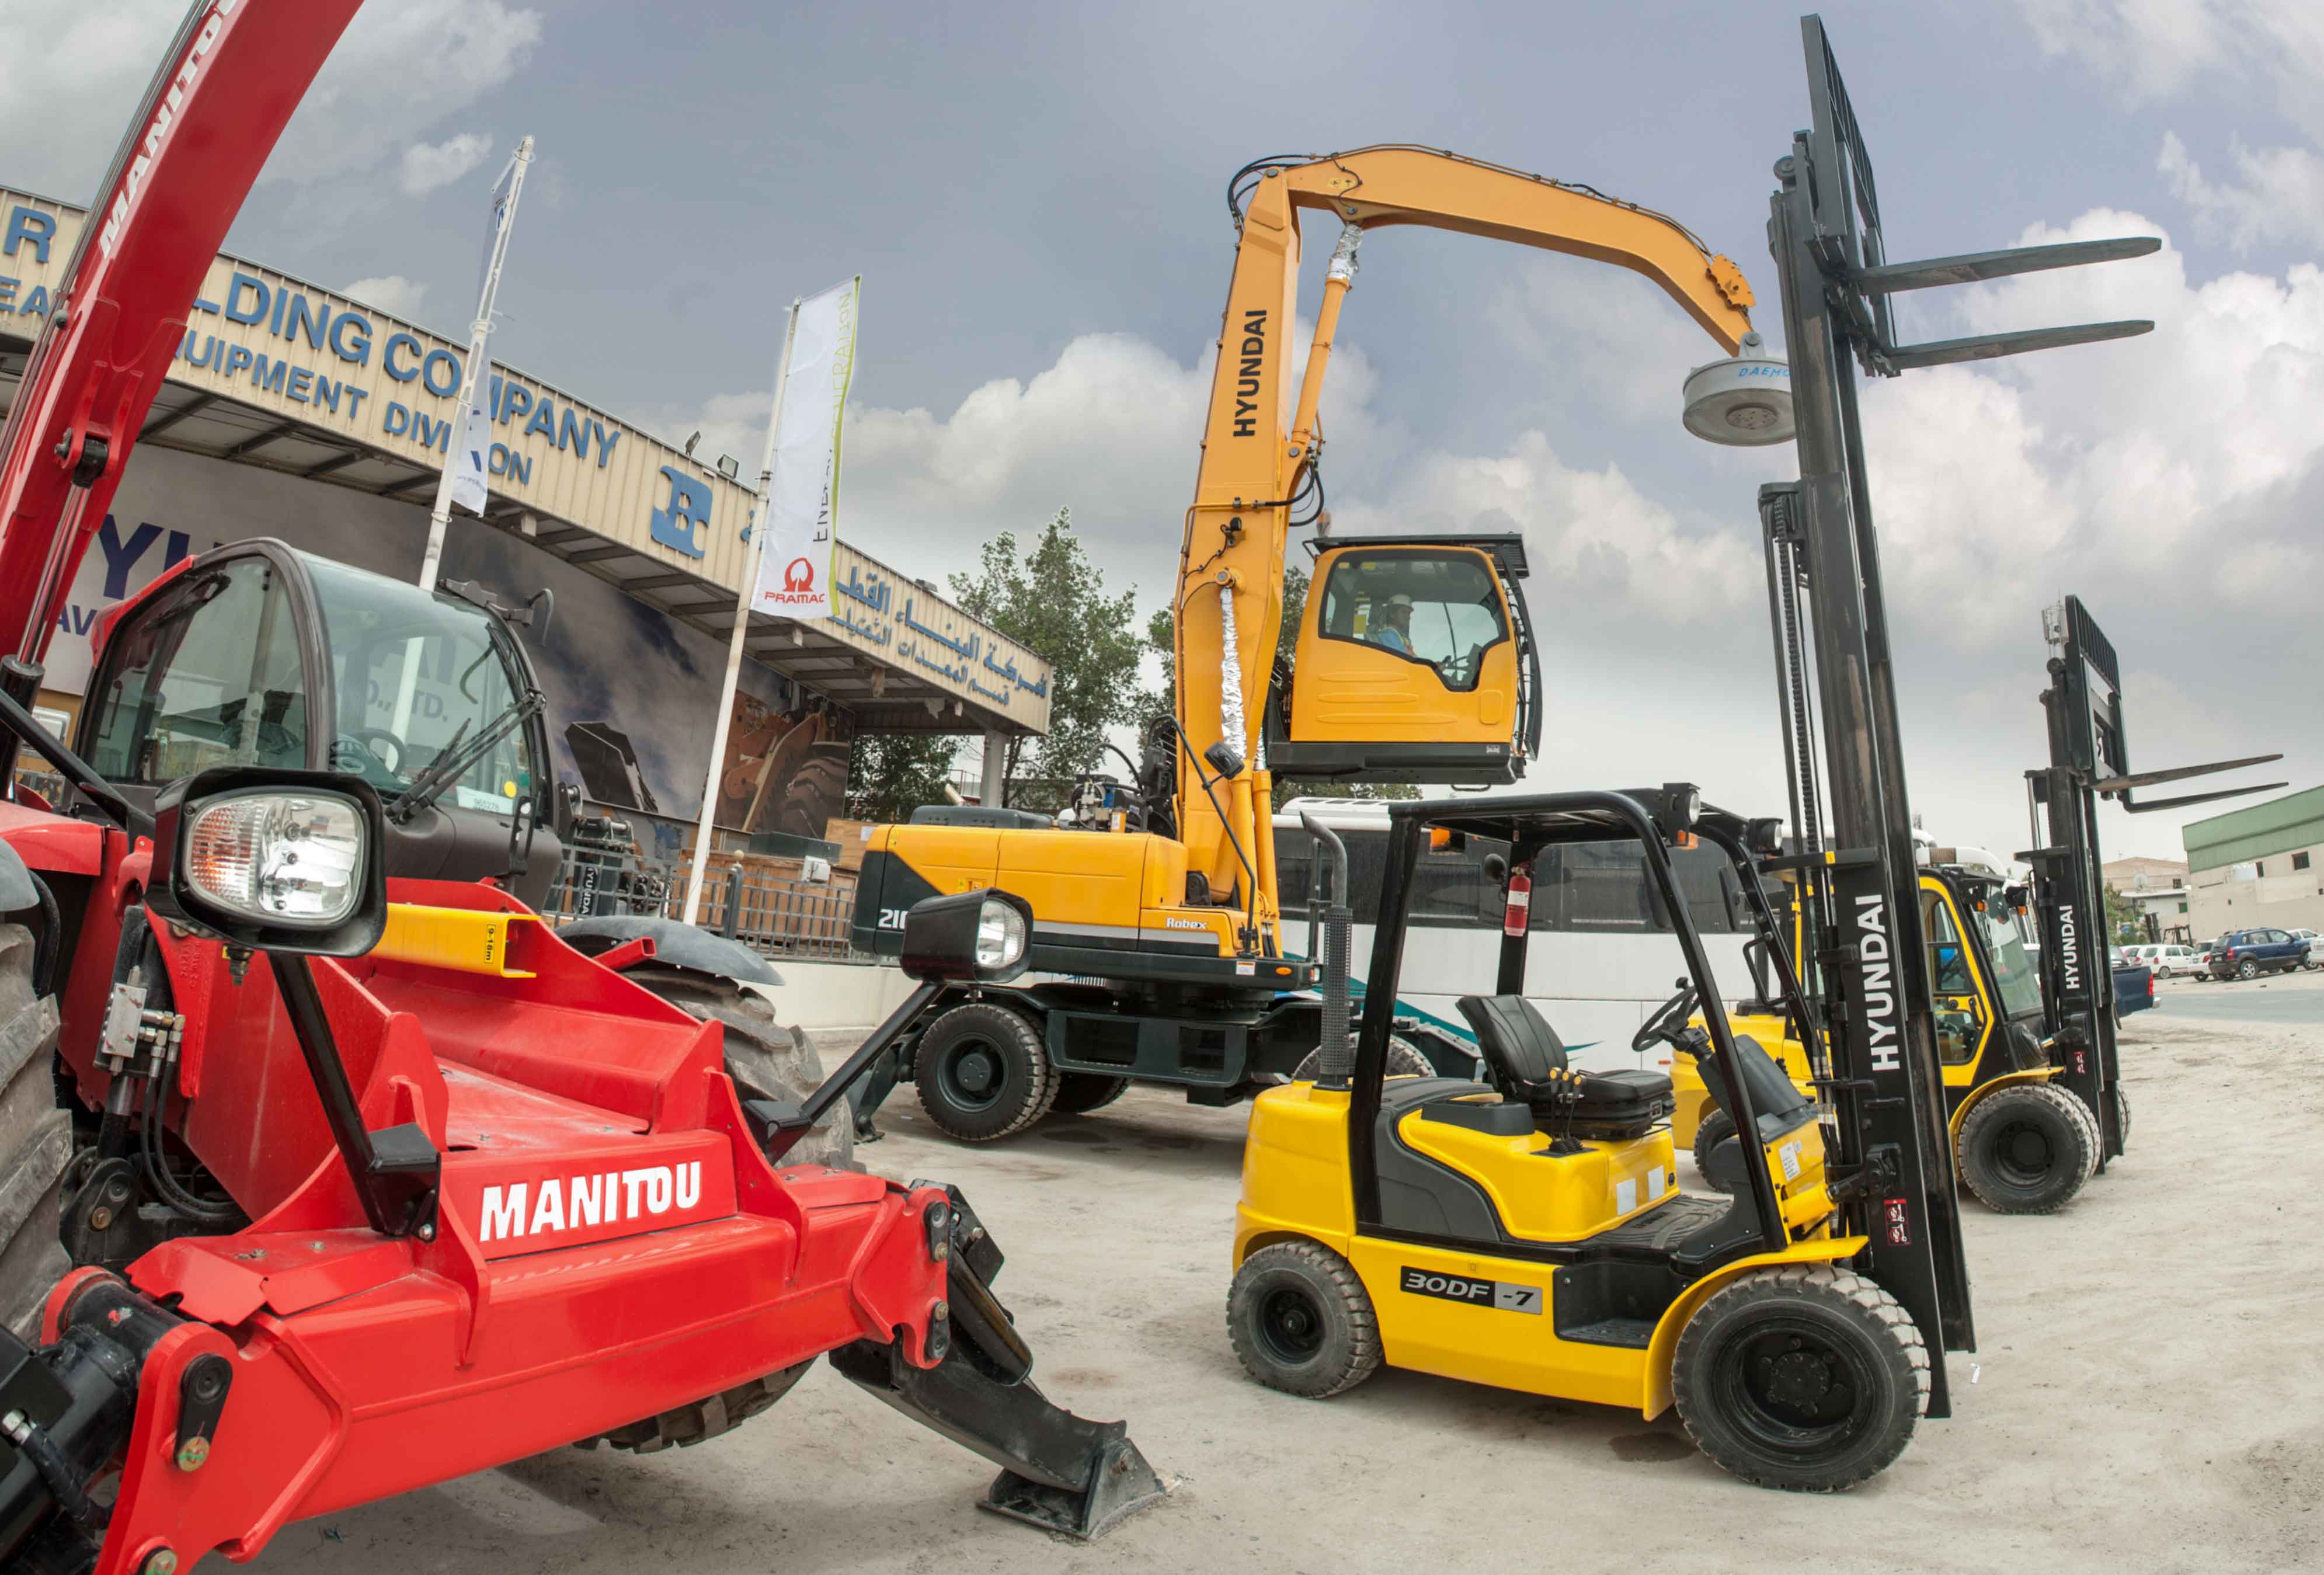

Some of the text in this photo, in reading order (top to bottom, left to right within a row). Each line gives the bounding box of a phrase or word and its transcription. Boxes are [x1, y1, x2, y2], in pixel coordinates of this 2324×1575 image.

[175, 329, 368, 419] UIPMENT
[384, 401, 532, 485] DIVION
[1233, 310, 1267, 437] HYUNDAI
[764, 591, 826, 604] PRAMAC
[1166, 917, 1208, 930] Robex
[2059, 905, 2081, 990] HYUNDAI
[1855, 894, 1900, 1072] HYUNDAI
[479, 1160, 702, 1242] MANITOU
[1405, 1272, 1490, 1299] 30DF
